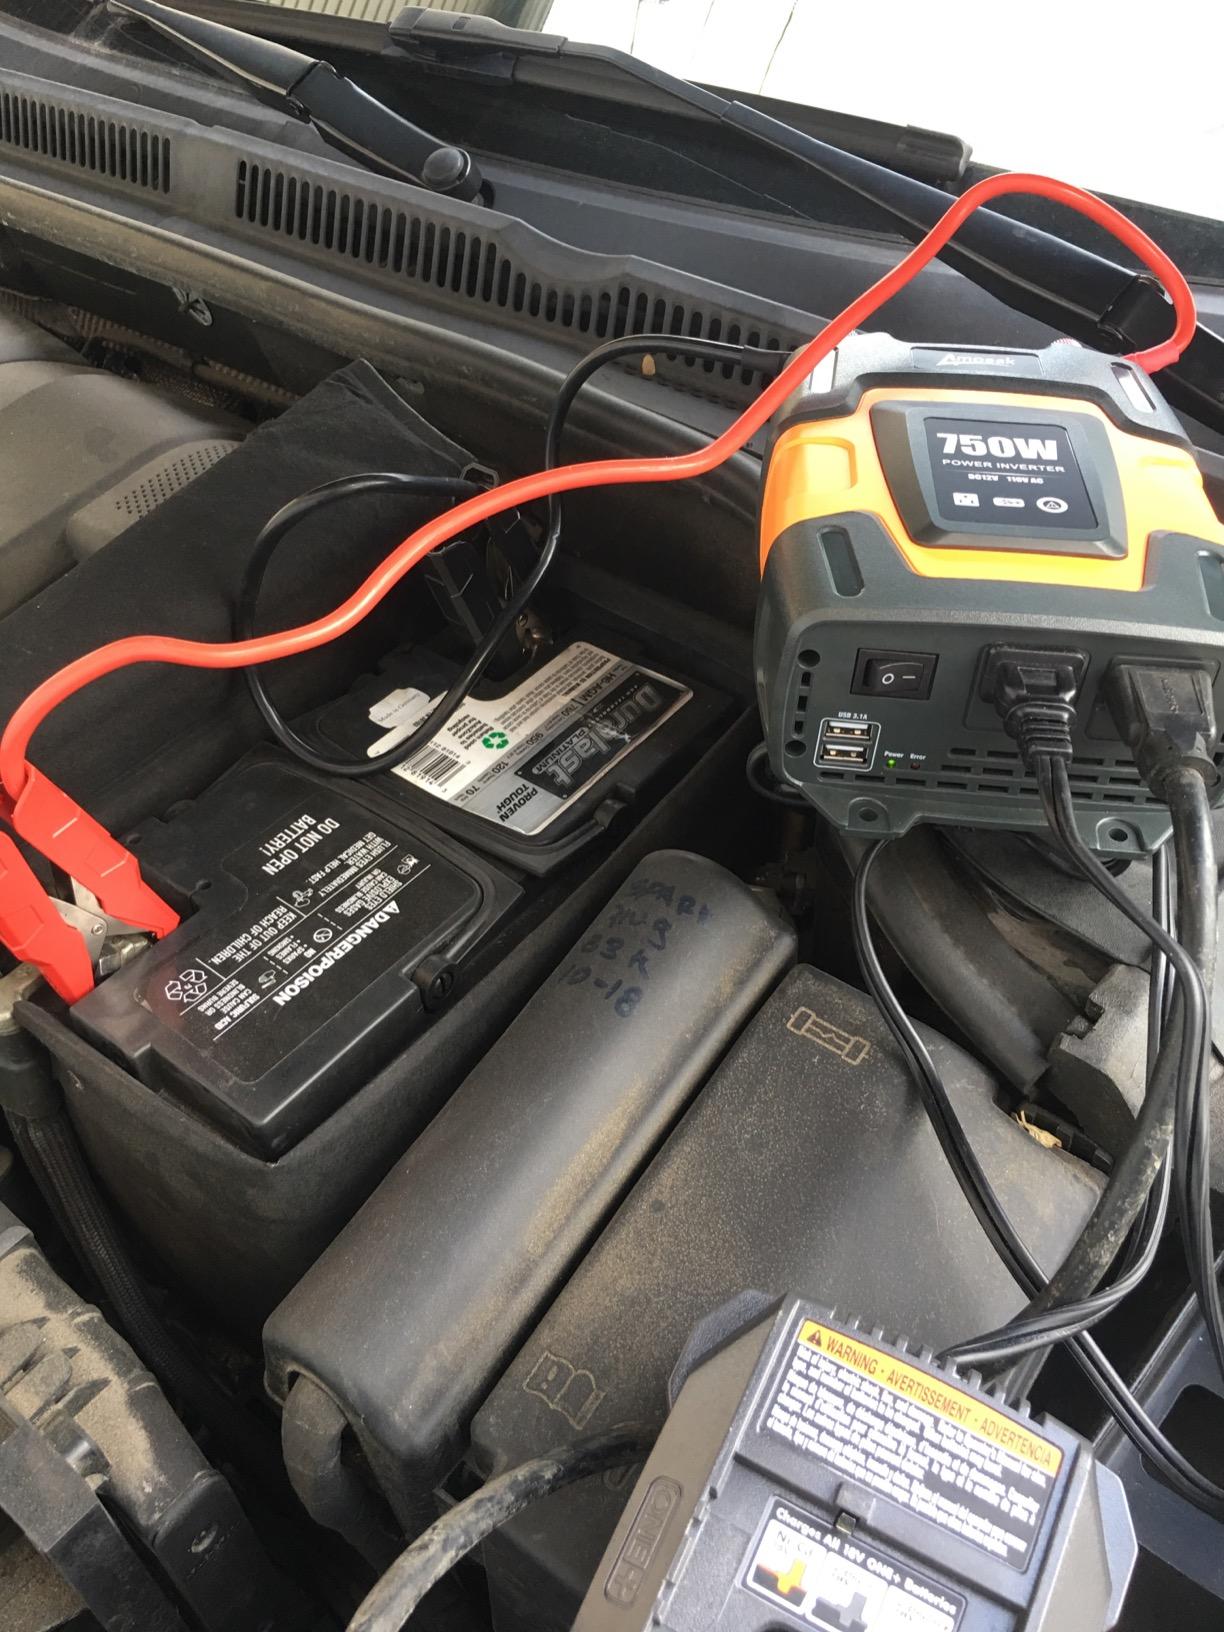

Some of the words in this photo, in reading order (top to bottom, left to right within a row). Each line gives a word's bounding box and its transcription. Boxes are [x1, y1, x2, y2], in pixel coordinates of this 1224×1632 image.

[936, 433, 1058, 461] 750W
[942, 459, 992, 469] POWER
[996, 462, 1066, 473] INVERTER
[838, 711, 852, 719] USB
[524, 731, 543, 747] 950
[533, 727, 586, 773] PLATINUM
[884, 750, 904, 759] Power
[490, 760, 508, 775] 120
[464, 784, 479, 796] 70
[495, 783, 529, 811] TOUGH
[498, 787, 537, 821] PROVEN
[316, 817, 340, 834] DO
[258, 813, 316, 856] BATTERY!
[293, 829, 323, 853] NOT
[362, 831, 376, 842] GET
[365, 836, 384, 850] WITH
[337, 839, 365, 861] MEDICAL
[369, 840, 391, 857] FLUSH
[261, 848, 299, 875] OPEN
[323, 858, 340, 873] HELP
[355, 854, 372, 868] EYES
[305, 869, 325, 884] FAST.
[317, 865, 358, 897] IMMEDIATELY
[258, 904, 287, 928] REACH
[274, 911, 296, 930] KEEP
[248, 924, 262, 937] OF
[258, 925, 277, 942] OUT
[207, 932, 252, 965] CHILDREN.
[248, 938, 262, 951] OF
[274, 941, 298, 960] FLAMES
[303, 947, 316, 959] NO
[231, 947, 250, 963] THE
[271, 910, 389, 1005] DANGER/POISON
[237, 988, 252, 1000] CAN
[204, 1006, 215, 1016] OR
[219, 997, 240, 1014] CAUSE
[213, 1015, 231, 1030] ACID
[824, 1336, 880, 1375] WARNING
[886, 1368, 972, 1423] AVERTISSEMENT
[979, 1416, 1053, 1466] ADVERTENCIA
[772, 1506, 824, 1543] Charges
[822, 1532, 842, 1550] All
[901, 1577, 958, 1616] Batteries
